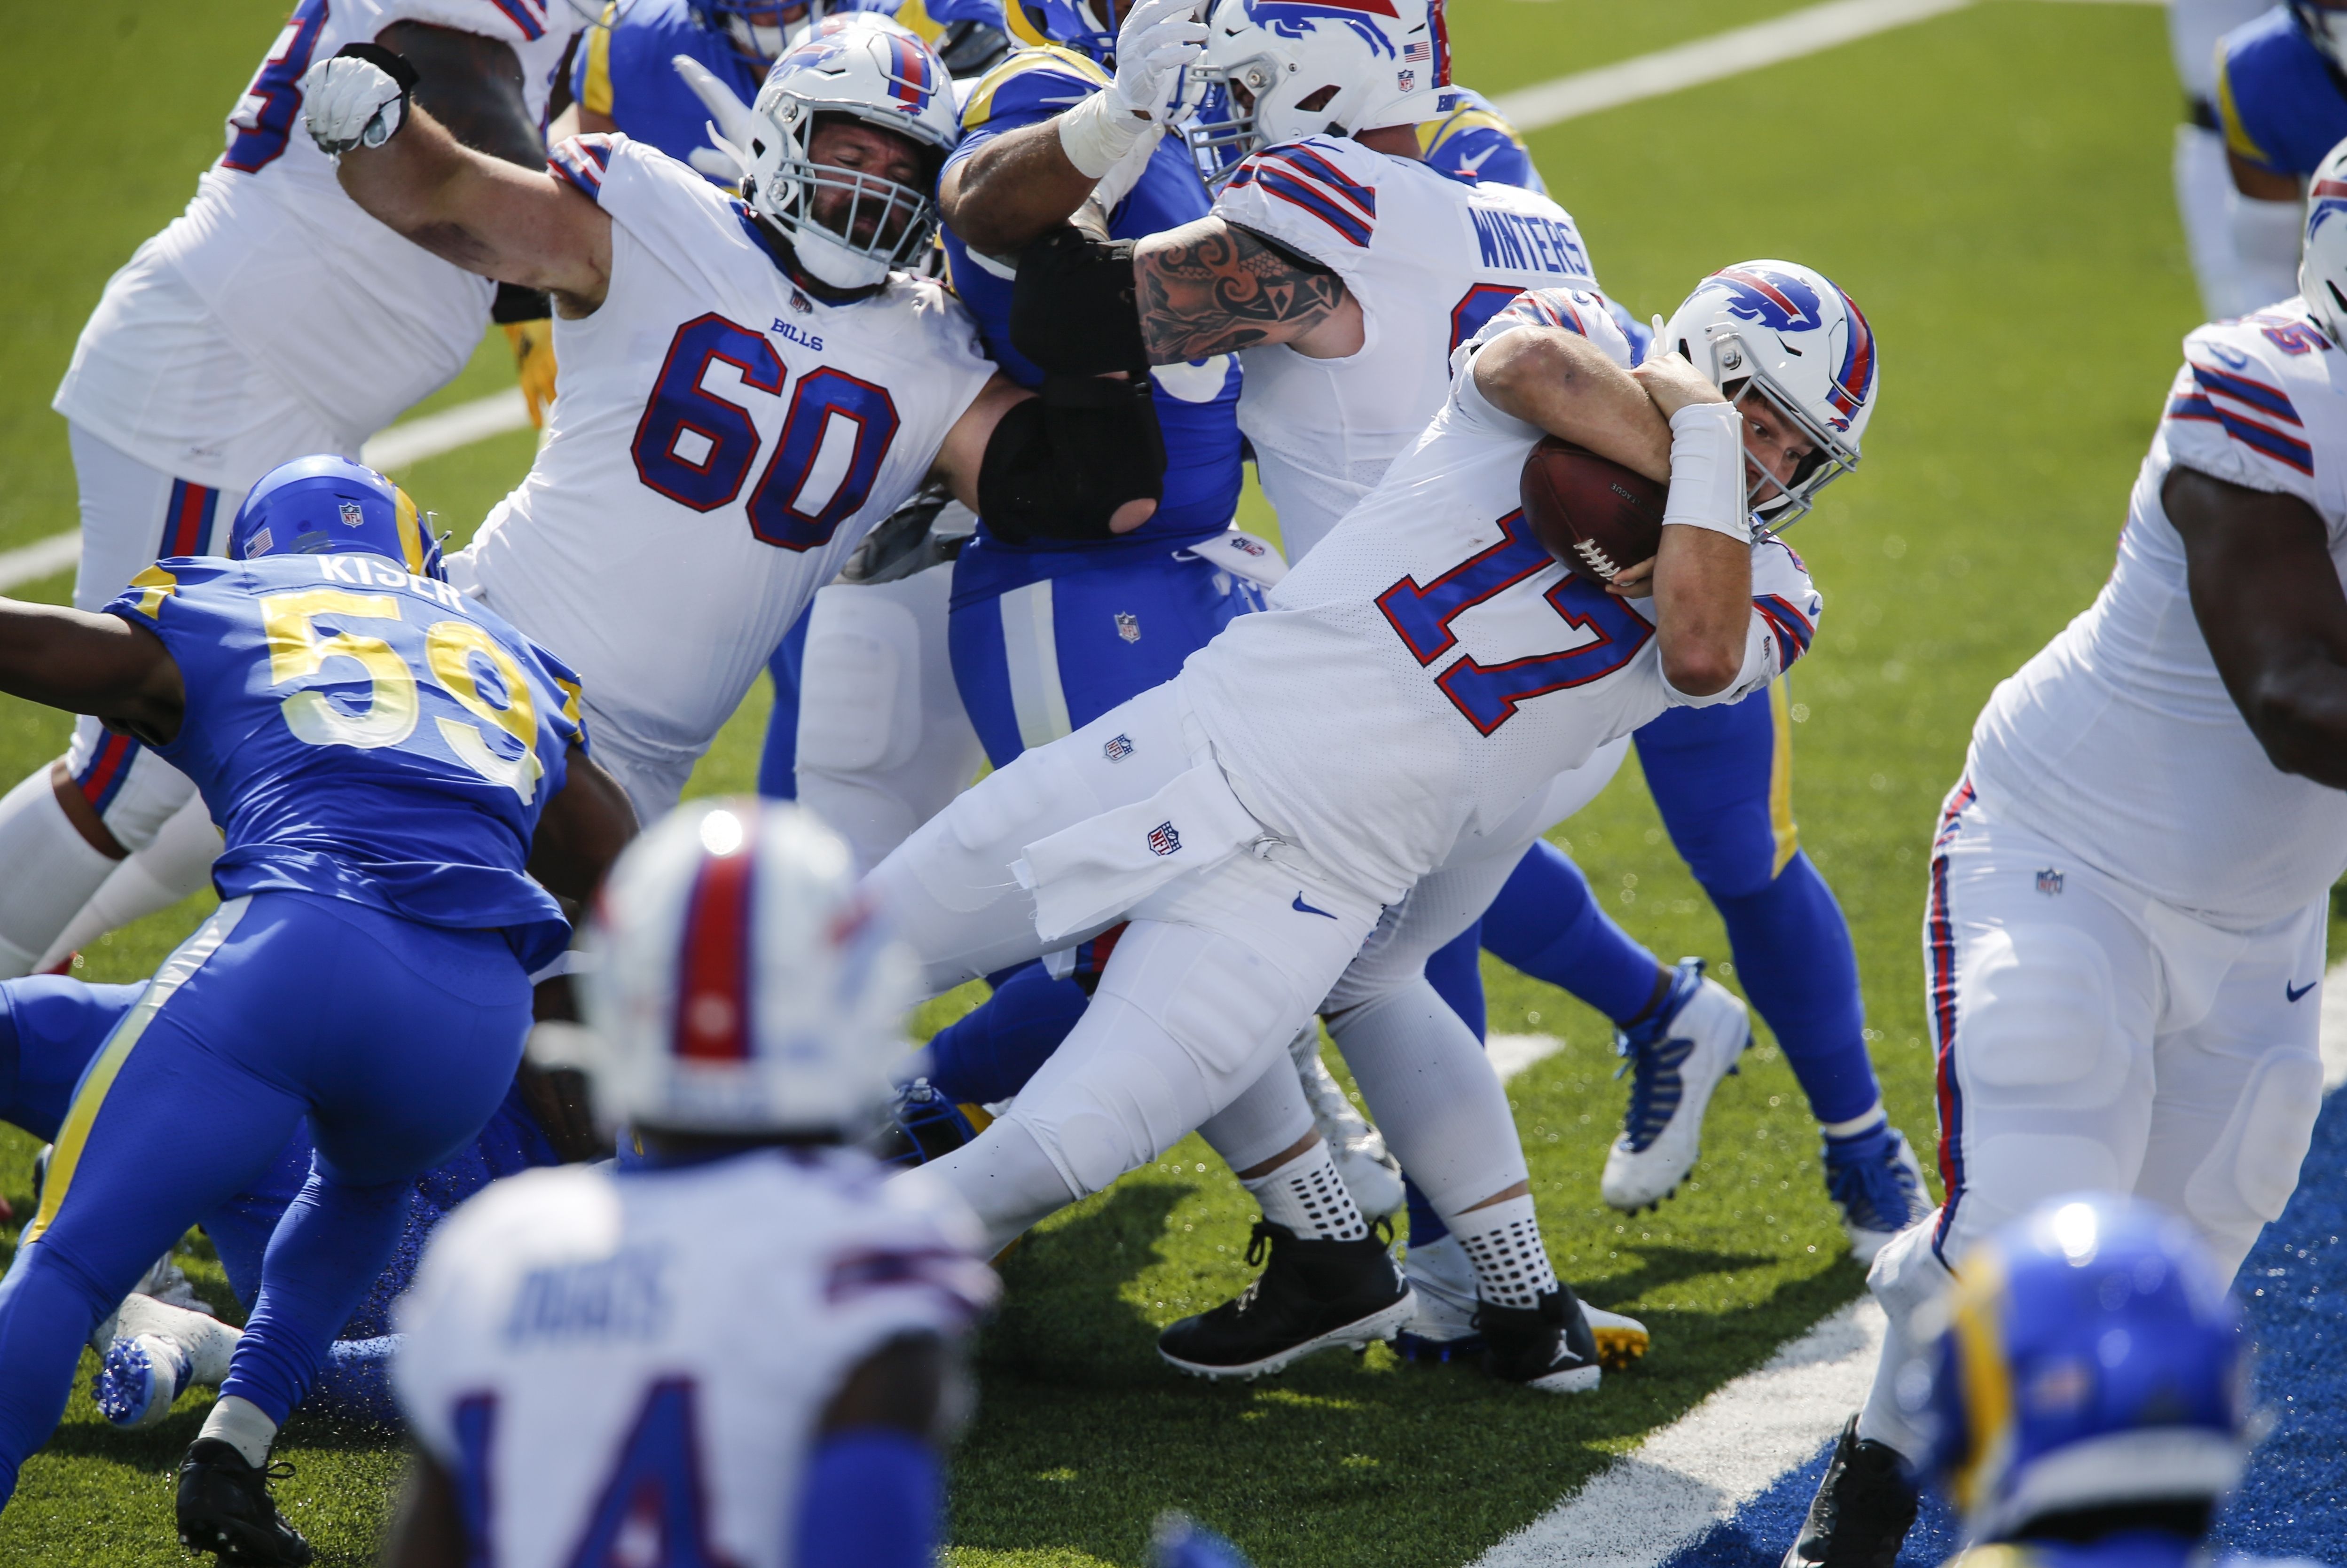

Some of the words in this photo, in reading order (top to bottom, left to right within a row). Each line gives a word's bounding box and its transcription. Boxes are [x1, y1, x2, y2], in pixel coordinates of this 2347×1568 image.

[1468, 207, 1587, 275] WINTERS
[770, 317, 823, 351] BILLS
[631, 312, 901, 553] 60
[1610, 482, 1641, 506] LEAGUE
[316, 555, 468, 614] KISER
[1374, 507, 1656, 738] 17
[260, 589, 545, 806] 59
